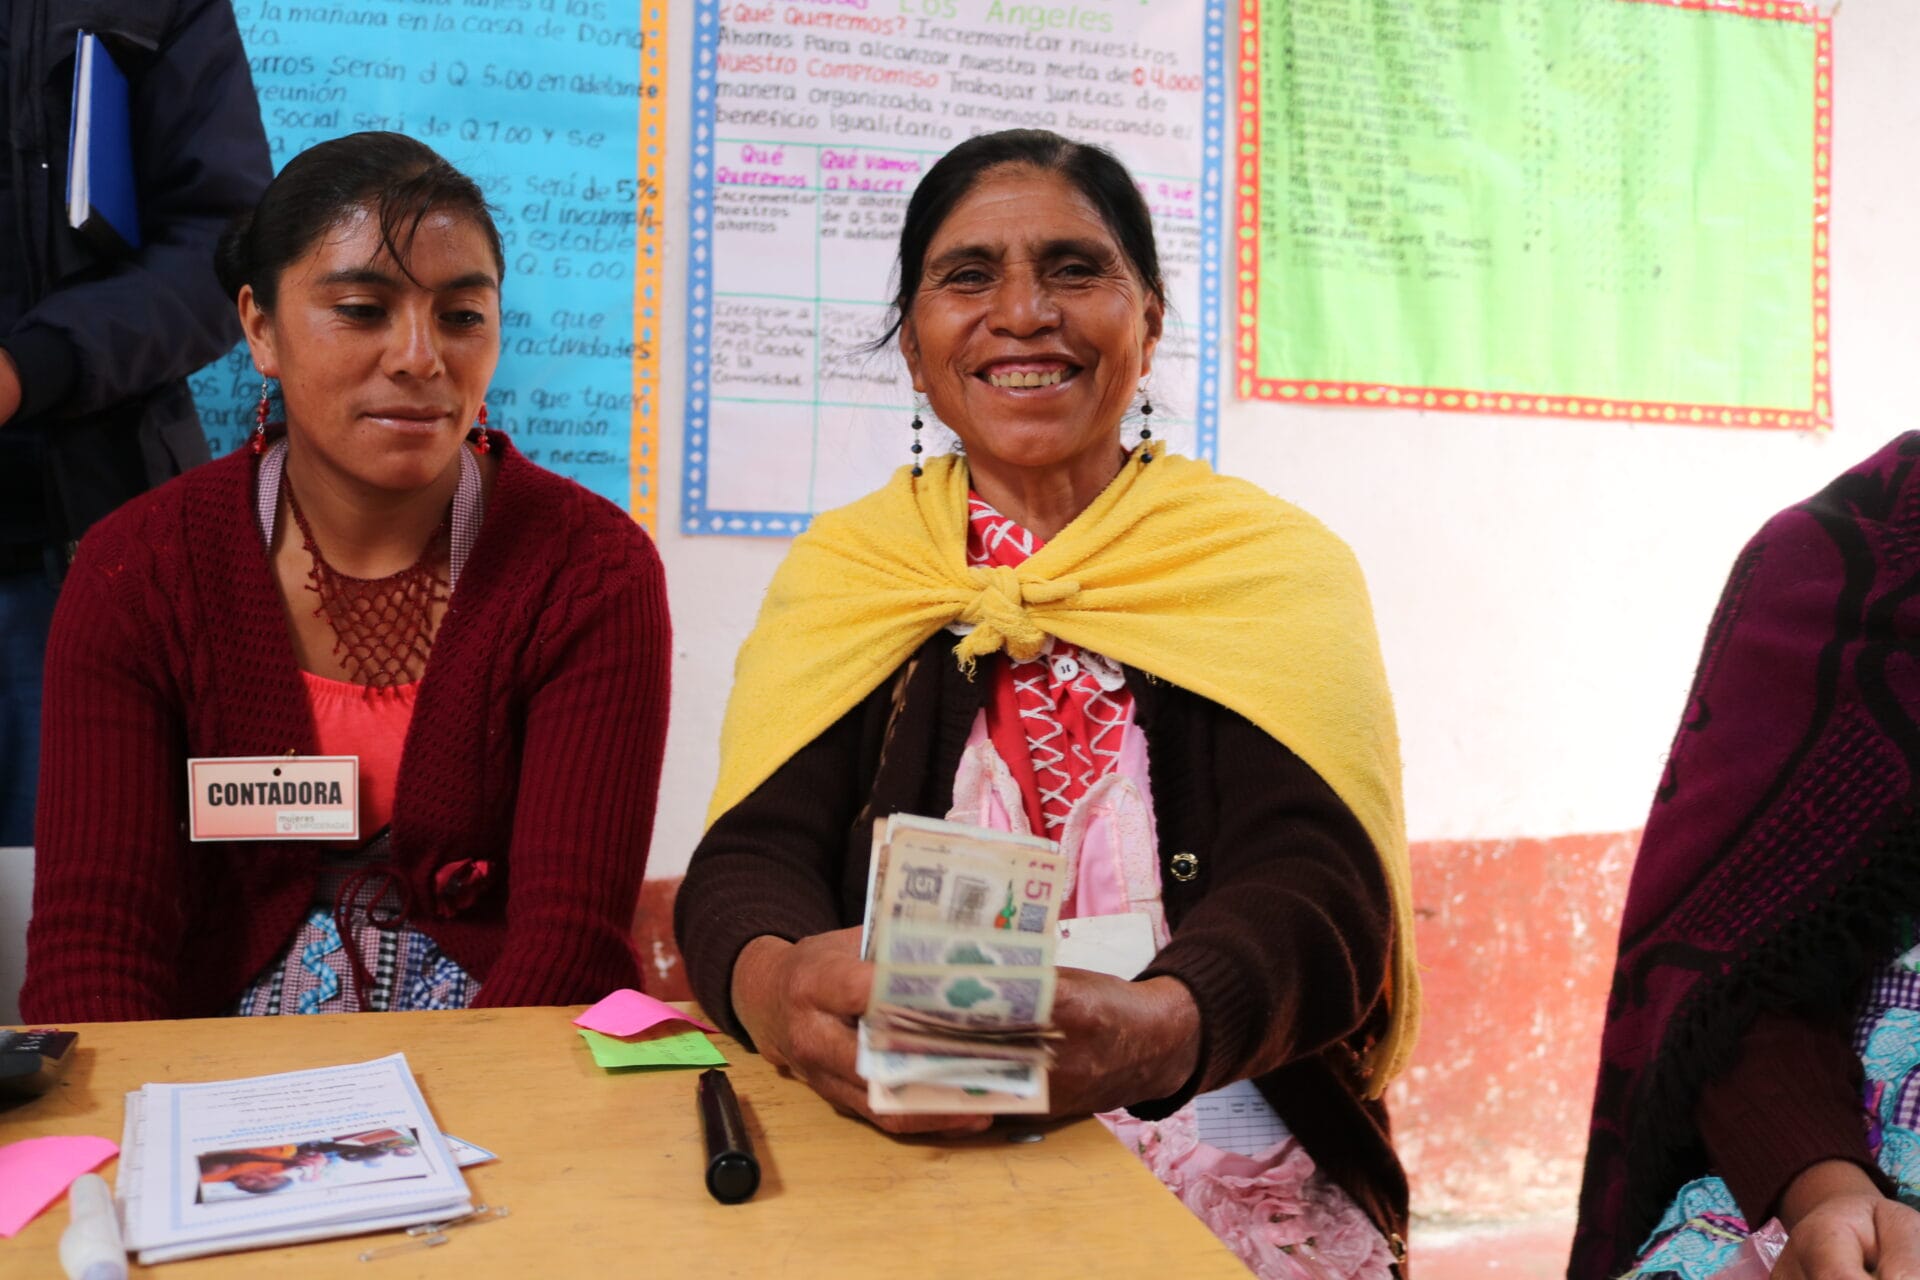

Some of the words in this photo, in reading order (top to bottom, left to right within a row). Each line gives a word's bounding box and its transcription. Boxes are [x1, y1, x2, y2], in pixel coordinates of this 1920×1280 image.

[260, 2, 282, 21] la
[288, 2, 389, 28] mañana
[397, 12, 428, 31] en
[433, 12, 455, 32] la
[462, 15, 525, 36] casa
[534, 19, 566, 38] de
[783, 6, 908, 36] Queremos?
[914, 17, 1063, 51] Incrementar
[1069, 38, 1180, 67] nuestros
[717, 25, 794, 49] Ahorros
[858, 41, 951, 65] alcanzar
[958, 53, 1037, 77] nuestra
[1045, 61, 1099, 82] meta
[1105, 66, 1132, 86] de
[447, 60, 469, 88] Q
[482, 63, 533, 90] 5.00
[537, 76, 567, 93] en
[716, 52, 798, 75] Nuestro
[805, 57, 940, 89] Compromiso
[947, 71, 1037, 102] Trabajar
[1135, 94, 1170, 113] de
[715, 81, 797, 100] manera
[808, 87, 933, 114] organizada
[953, 102, 1058, 128] armoniosa
[1066, 110, 1166, 138] buscando
[715, 104, 819, 130] beneficio
[419, 115, 450, 138] de
[567, 128, 606, 148] se
[740, 143, 785, 166] Qué
[820, 147, 858, 171] Qué
[864, 154, 922, 174] vamos
[582, 176, 611, 202] de
[616, 178, 660, 202] 5%
[715, 165, 808, 190] Queremos
[826, 176, 840, 191] a
[848, 173, 905, 193] hacer
[714, 187, 817, 206] Incrementar
[521, 199, 550, 225] el
[552, 256, 626, 280] 5.00
[550, 308, 606, 334] que
[514, 332, 653, 360] actividades
[530, 387, 571, 411] que
[527, 408, 609, 437] reunión
[208, 781, 342, 806] CONTADORA
[278, 815, 315, 825] mujeres
